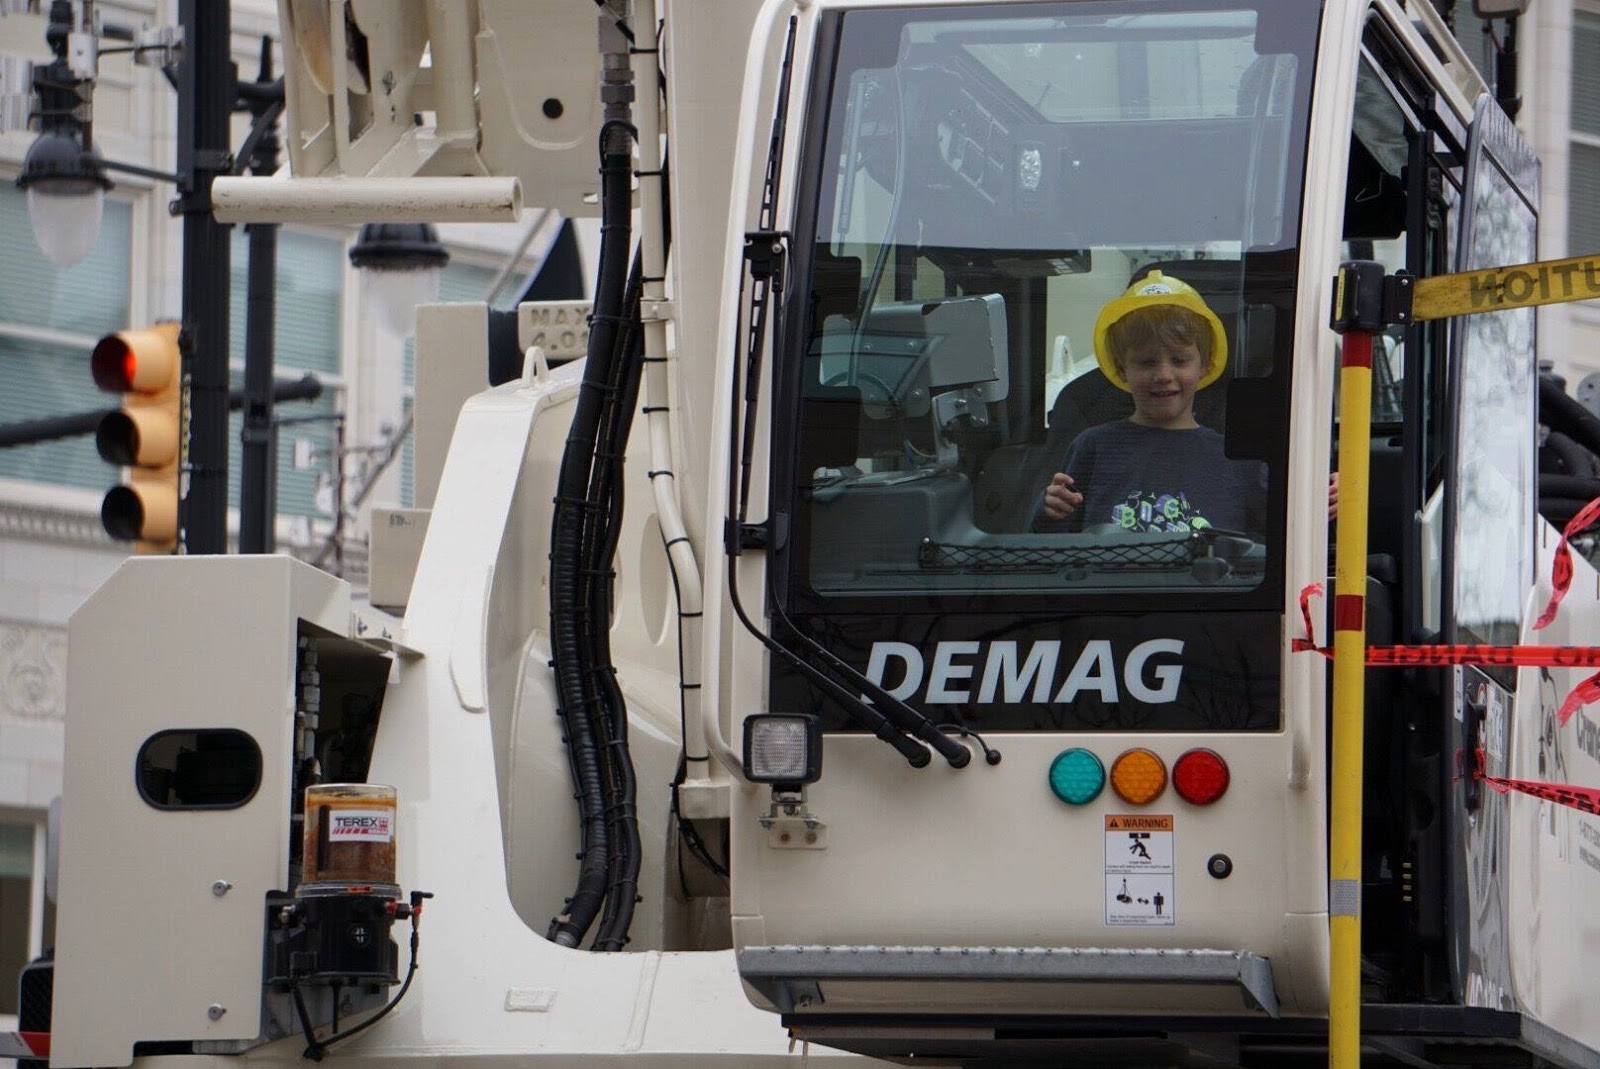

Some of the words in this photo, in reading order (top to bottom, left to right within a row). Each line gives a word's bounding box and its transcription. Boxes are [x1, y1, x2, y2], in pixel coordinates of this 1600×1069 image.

[860, 638, 1185, 704] DEMAG
[335, 816, 379, 827] TEREX
[1123, 818, 1168, 828] WARNING
